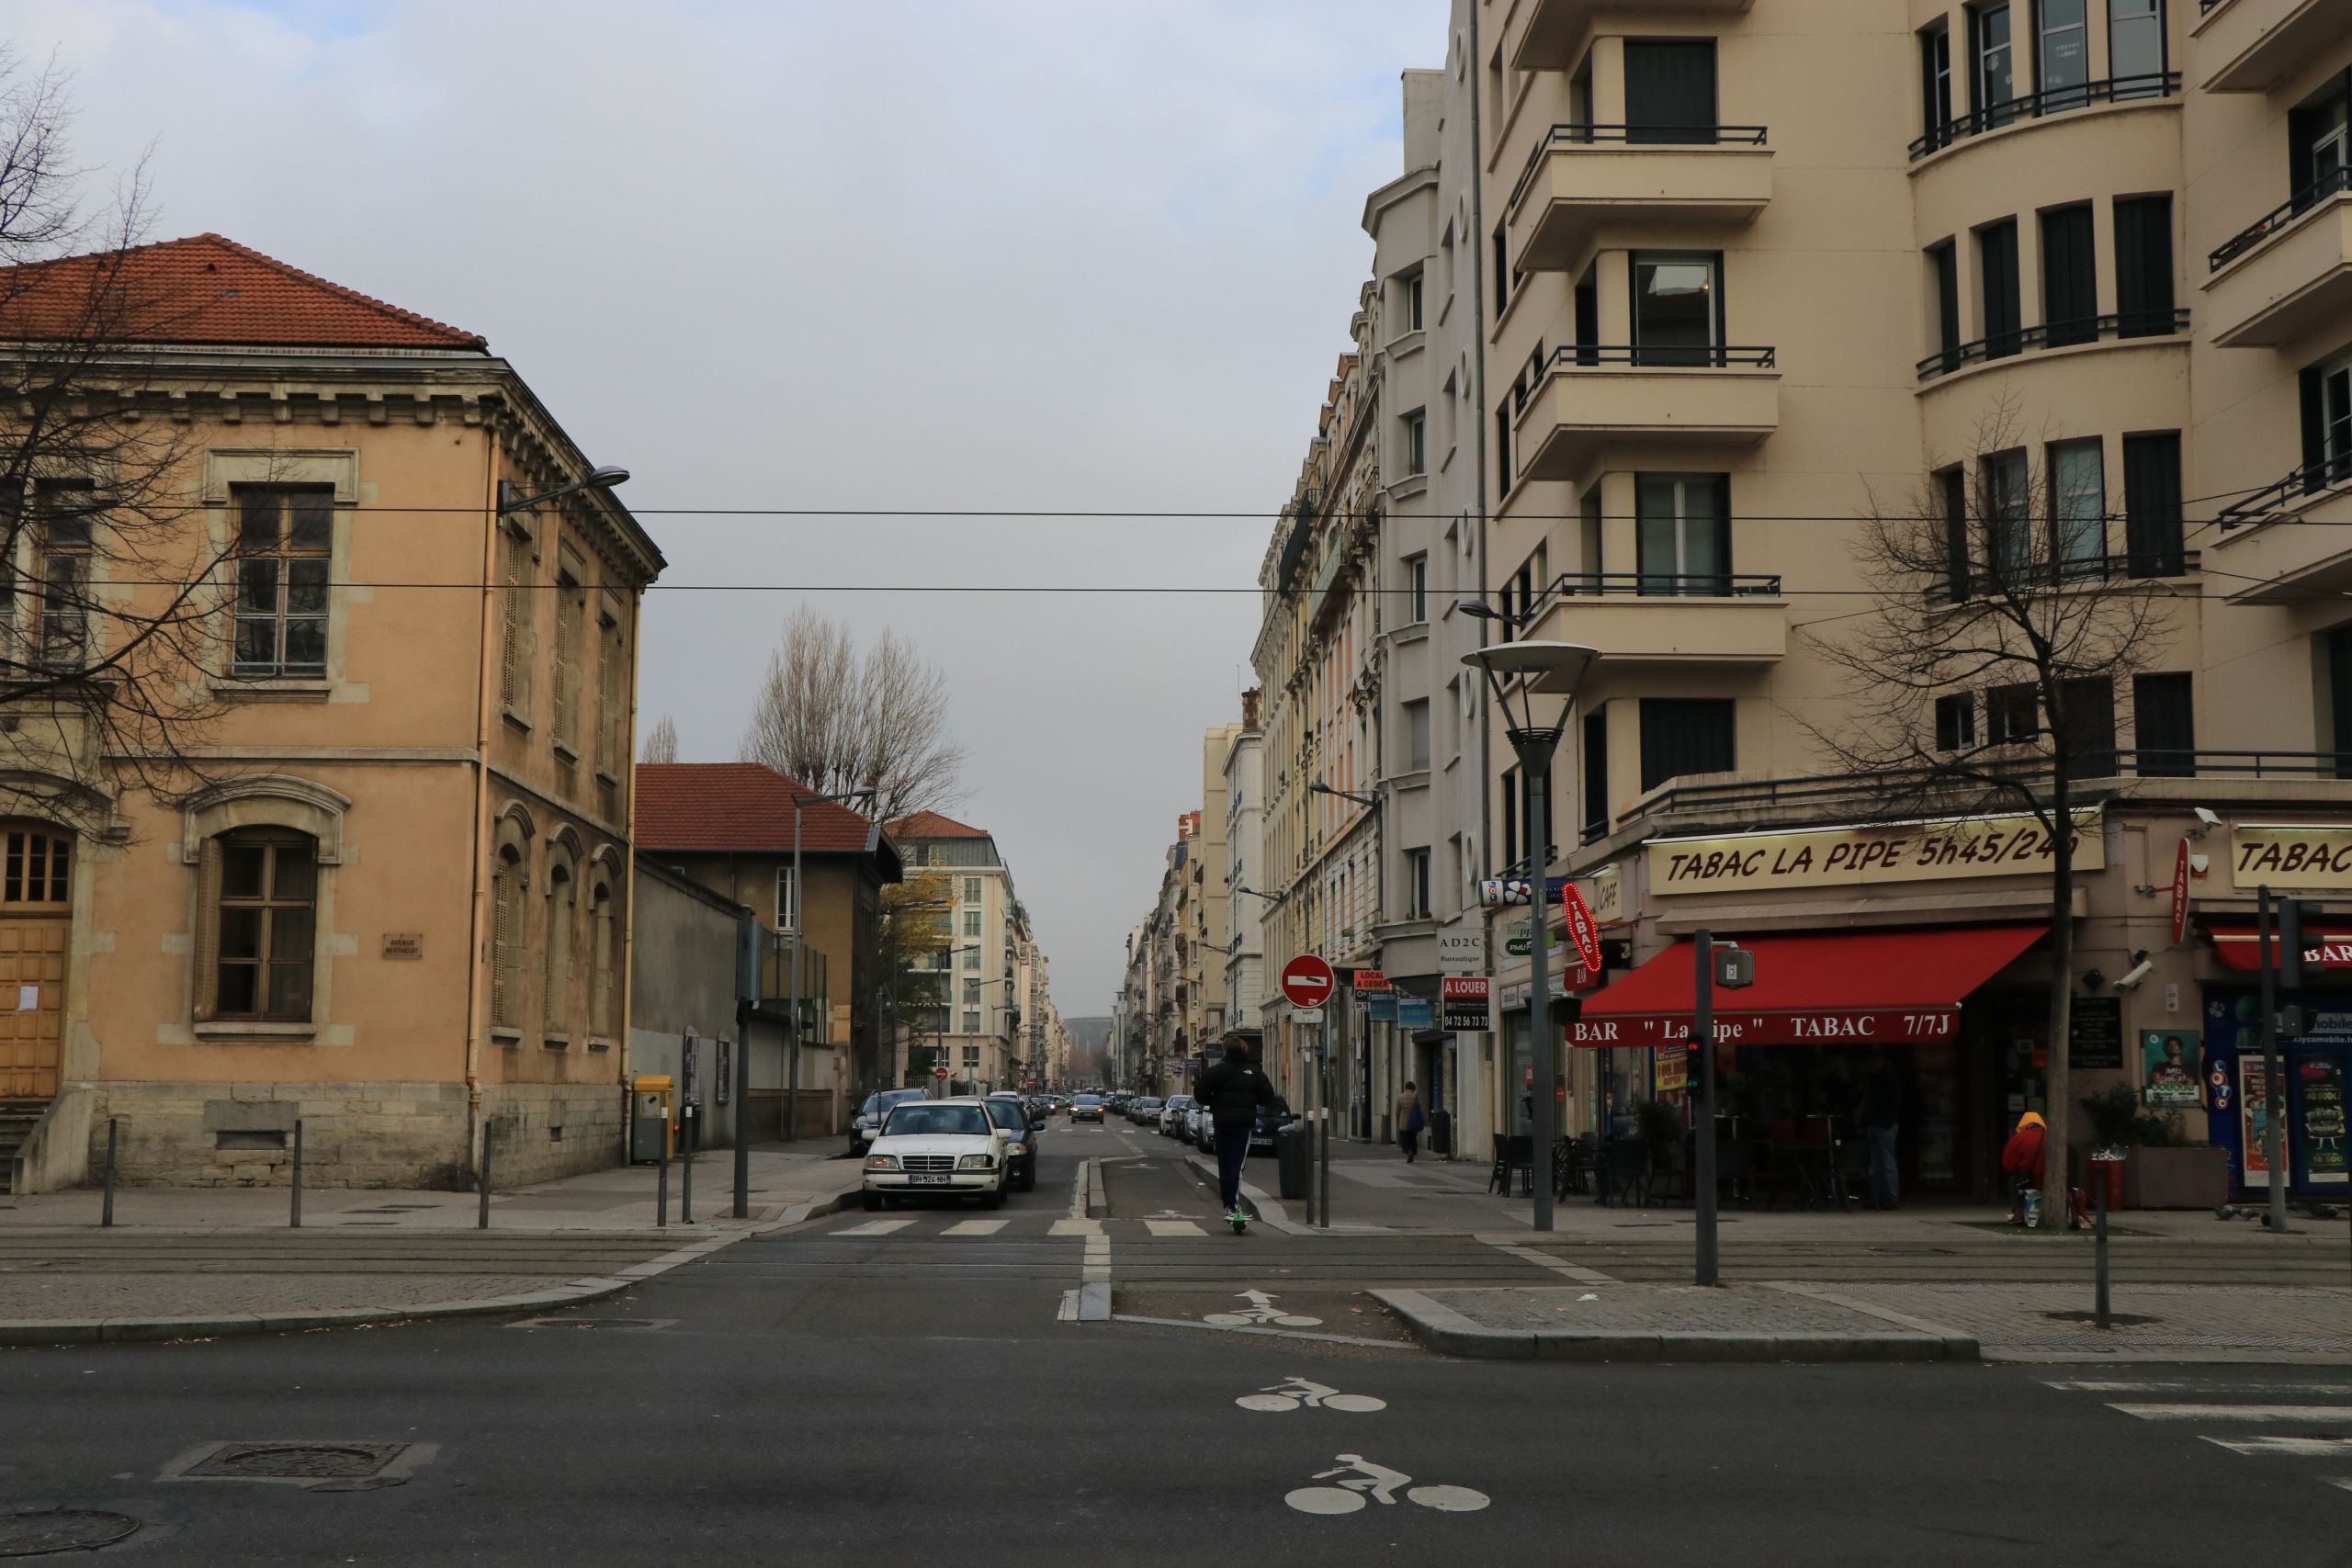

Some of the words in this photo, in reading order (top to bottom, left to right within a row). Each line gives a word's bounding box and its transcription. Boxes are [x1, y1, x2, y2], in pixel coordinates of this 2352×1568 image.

[1668, 850, 1766, 881] TABAC
[1771, 846, 1814, 874] LA
[1824, 840, 1906, 874] PIPE
[1917, 827, 2078, 865] 5h45/24
[2238, 842, 2352, 873] TABAC
[2175, 860, 2185, 923] TABAC
[1570, 901, 1594, 953] TABAC
[2303, 945, 2352, 962] BAR
[1445, 981, 1453, 993] A
[1455, 981, 1487, 994] LOUER
[1445, 1016, 1453, 1027] 04
[1454, 1016, 1462, 1027] 72
[1472, 1016, 1479, 1027] 73
[1481, 1016, 1488, 1027] 73
[1574, 1021, 1619, 1041] BAR
[1663, 1021, 1689, 1040] La
[1712, 1020, 1742, 1043] ipe
[1790, 1015, 1875, 1036] TABAC
[1903, 1014, 1950, 1035] 7/7J
